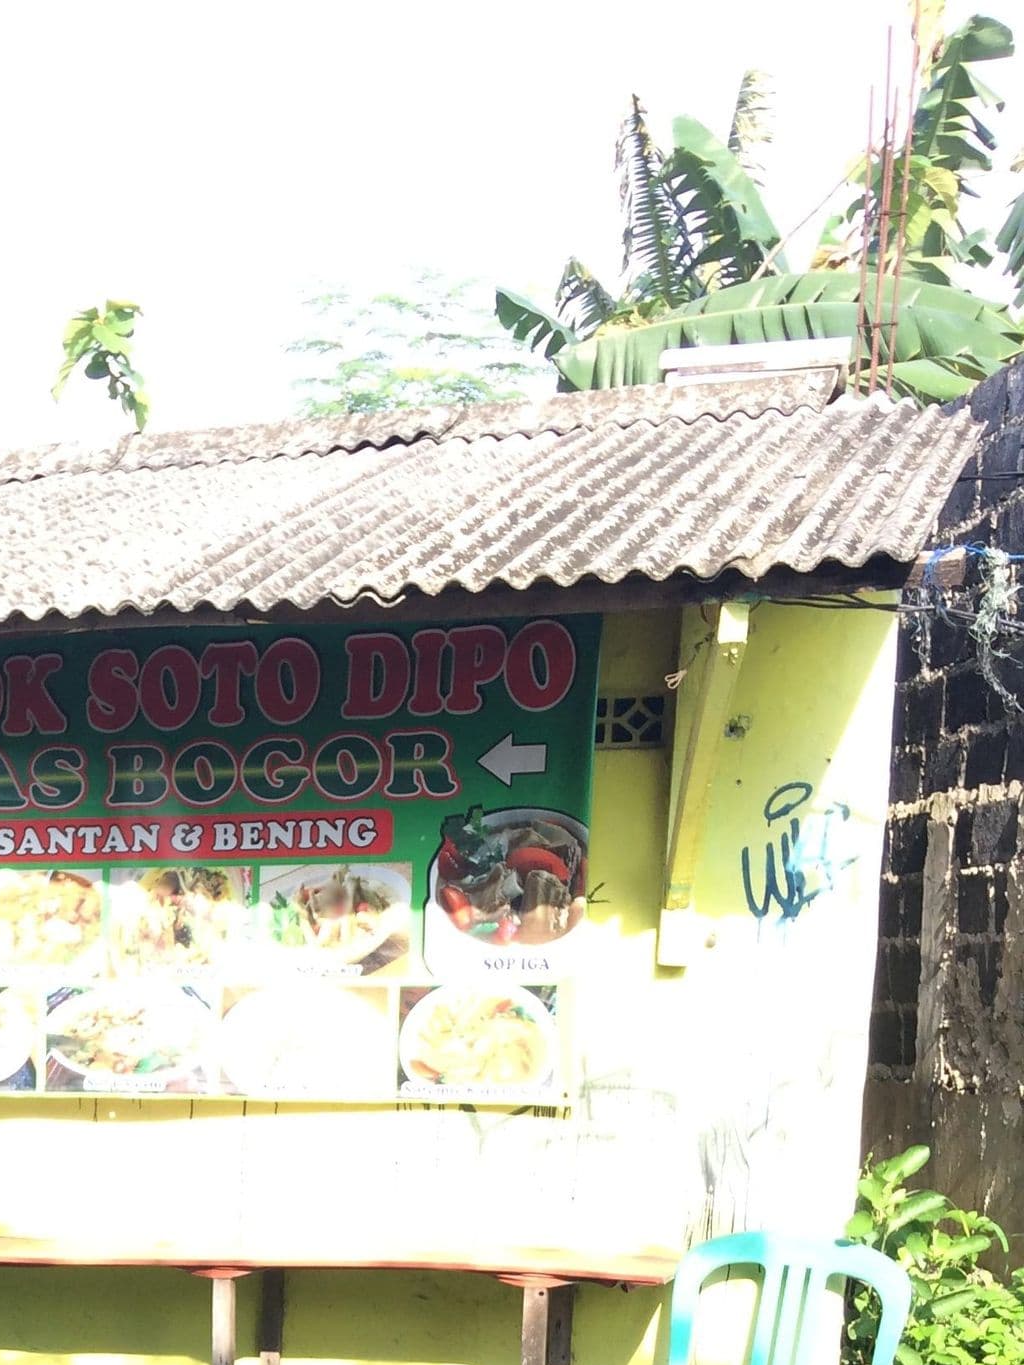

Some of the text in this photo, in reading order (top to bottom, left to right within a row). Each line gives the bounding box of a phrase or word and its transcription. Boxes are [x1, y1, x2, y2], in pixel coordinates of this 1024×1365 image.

[86, 637, 321, 733] SOTO
[341, 620, 576, 720] DIPO
[105, 727, 461, 808] BOGOR
[171, 823, 203, 853] &
[212, 817, 377, 853] BENING
[484, 957, 550, 970] SOP IGA
